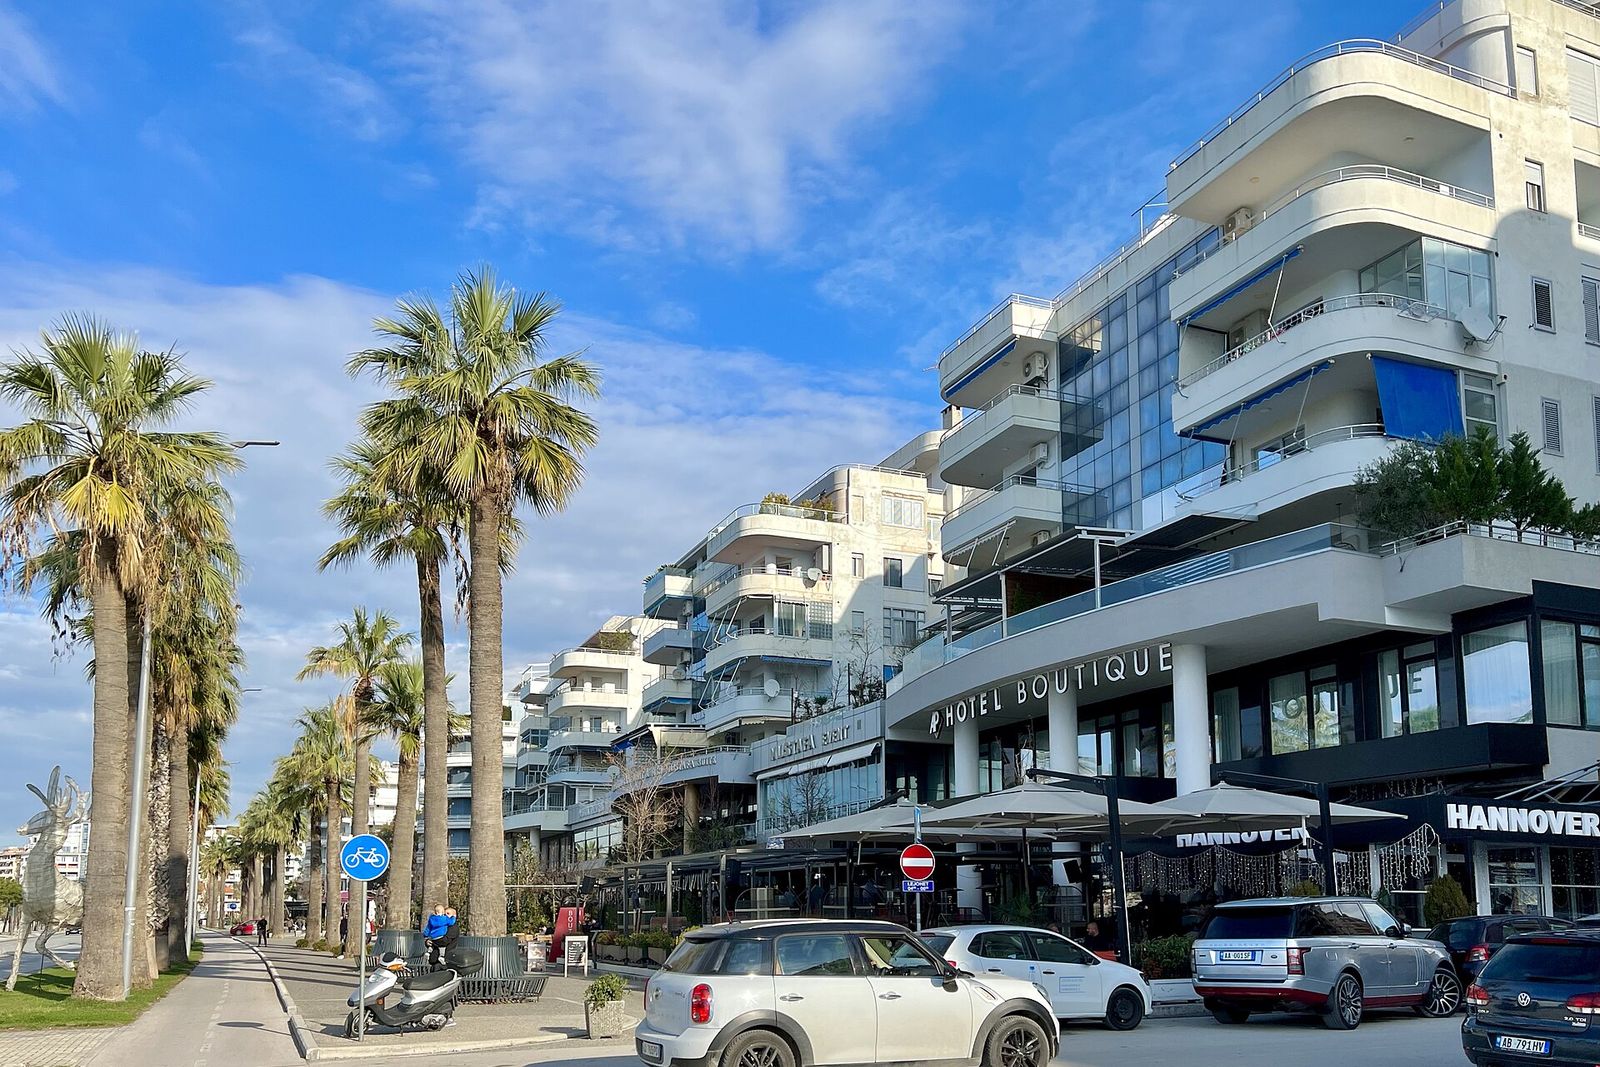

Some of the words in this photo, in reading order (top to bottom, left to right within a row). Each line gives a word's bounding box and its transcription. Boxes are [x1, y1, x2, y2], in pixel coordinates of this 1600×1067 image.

[945, 687, 1002, 727] HOTEL
[1017, 643, 1173, 704] BOUTIQUE
[822, 725, 849, 746] EVENT
[1447, 803, 1600, 837] HANNOVER
[1502, 1037, 1512, 1048] AB
